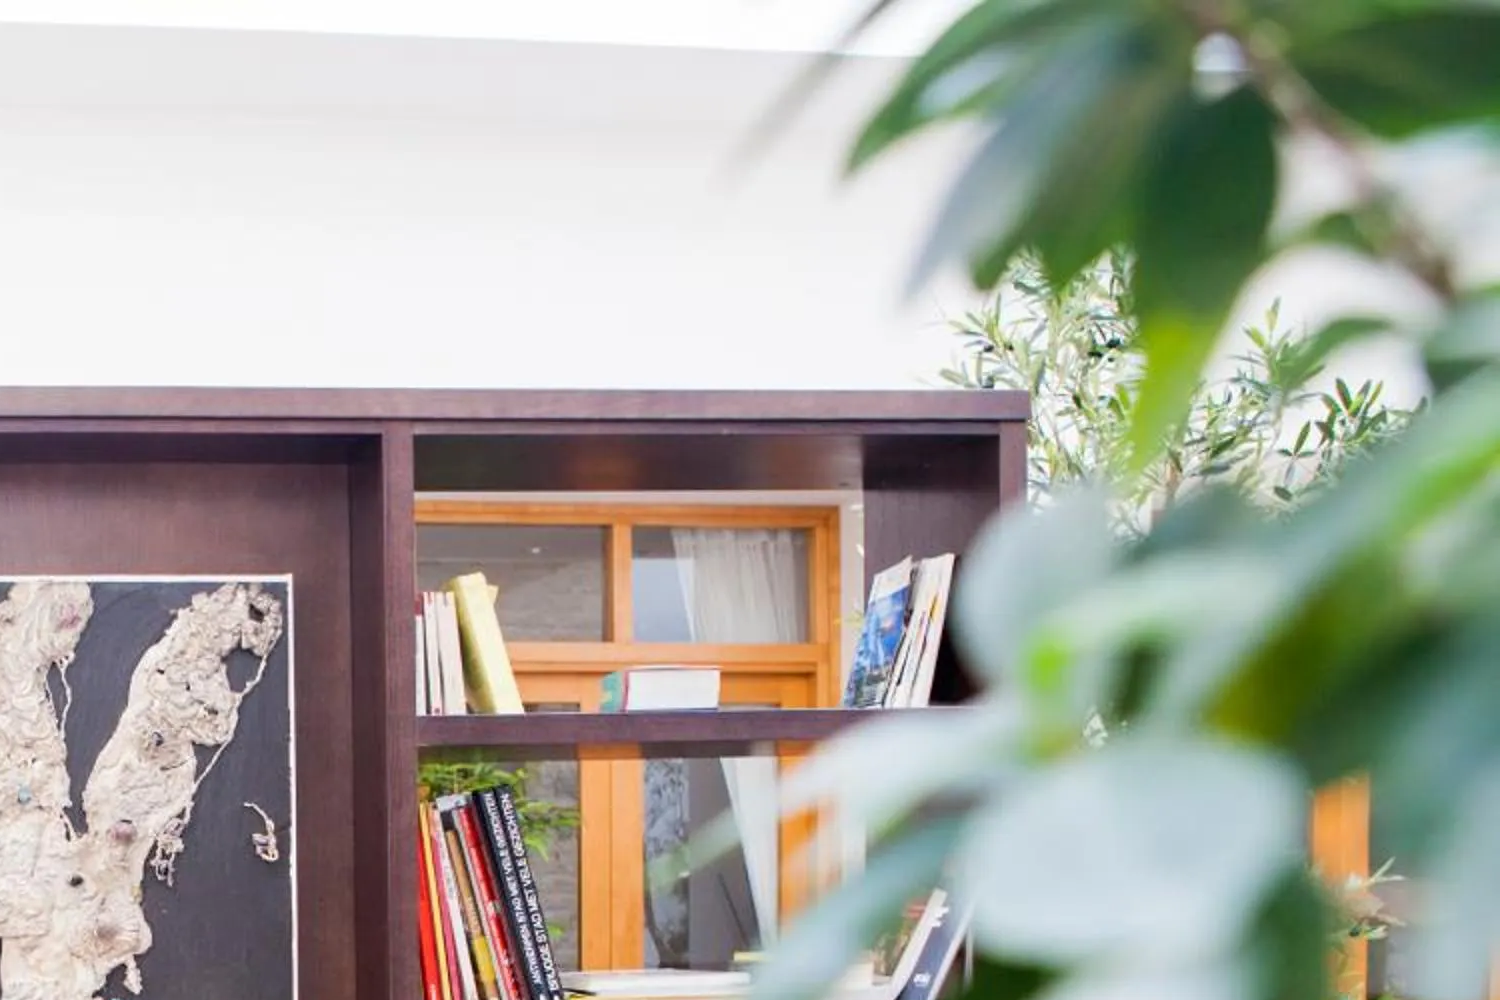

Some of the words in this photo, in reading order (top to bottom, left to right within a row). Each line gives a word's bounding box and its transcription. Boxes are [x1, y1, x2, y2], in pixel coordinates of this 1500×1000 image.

[515, 856, 532, 886] VELE
[523, 886, 539, 911] MET
[529, 911, 547, 943] STAD
